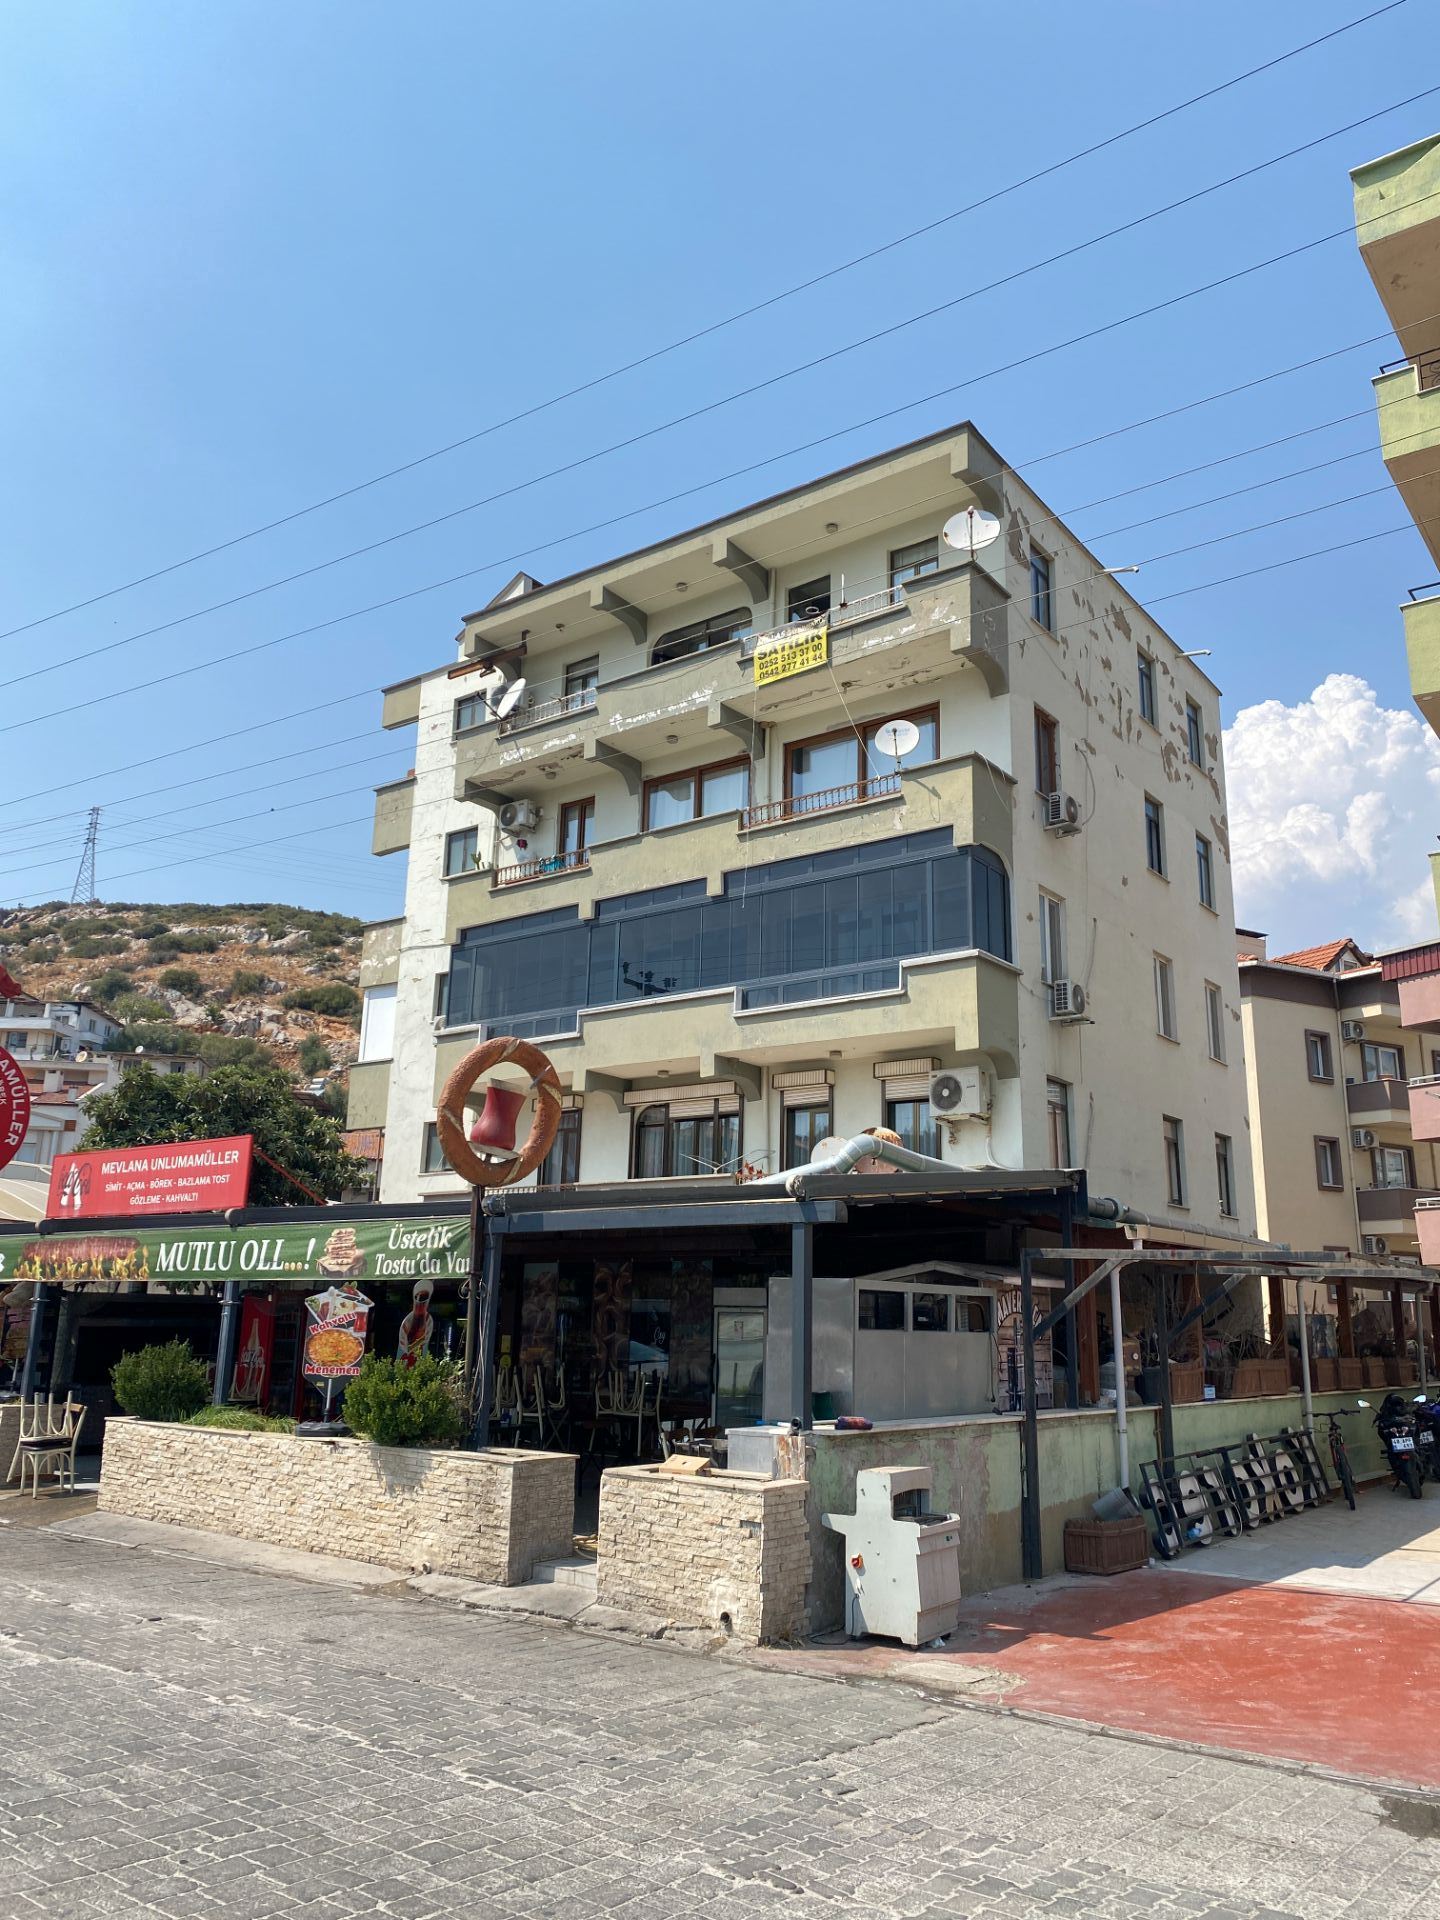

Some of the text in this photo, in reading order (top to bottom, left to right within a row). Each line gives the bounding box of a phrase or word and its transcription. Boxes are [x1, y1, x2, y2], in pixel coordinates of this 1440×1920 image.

[759, 642, 823, 670] 0252 513 37 00
[759, 667, 779, 680] 0542
[781, 661, 797, 673] 277
[101, 1150, 239, 1175] MEVLANA UNLUMAMÜLLER
[126, 1181, 145, 1192] AÇMA
[150, 1176, 173, 1189] BÖREK
[178, 1175, 211, 1188] BAZLAMA
[212, 1174, 230, 1184] TOST
[130, 1194, 198, 1205] GÖZLEME KAHVALTI
[388, 1221, 453, 1249] Üstelik
[155, 1240, 237, 1272] MUTLU
[374, 1251, 441, 1275] Tostu'da
[309, 1312, 357, 1334] Kahvaltı
[305, 1364, 360, 1375] Menemen
